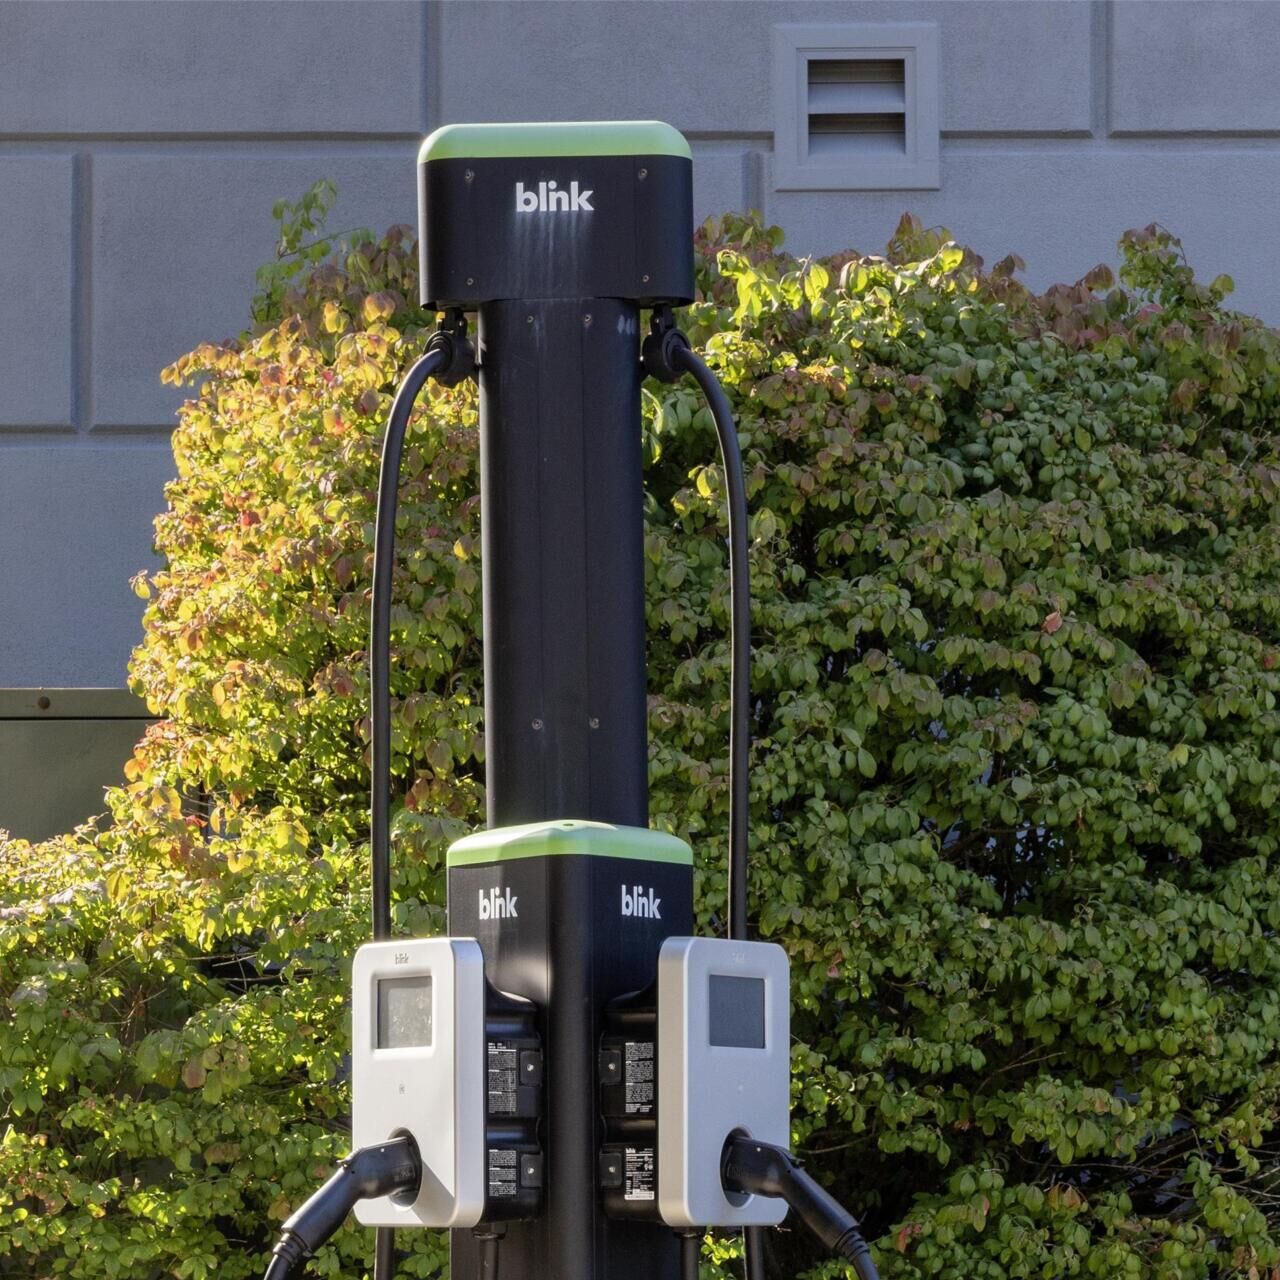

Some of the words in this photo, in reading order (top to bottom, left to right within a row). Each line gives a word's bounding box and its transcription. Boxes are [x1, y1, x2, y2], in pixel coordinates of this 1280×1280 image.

[516, 180, 595, 213] blink
[478, 886, 518, 920] blink
[621, 885, 661, 920] blink
